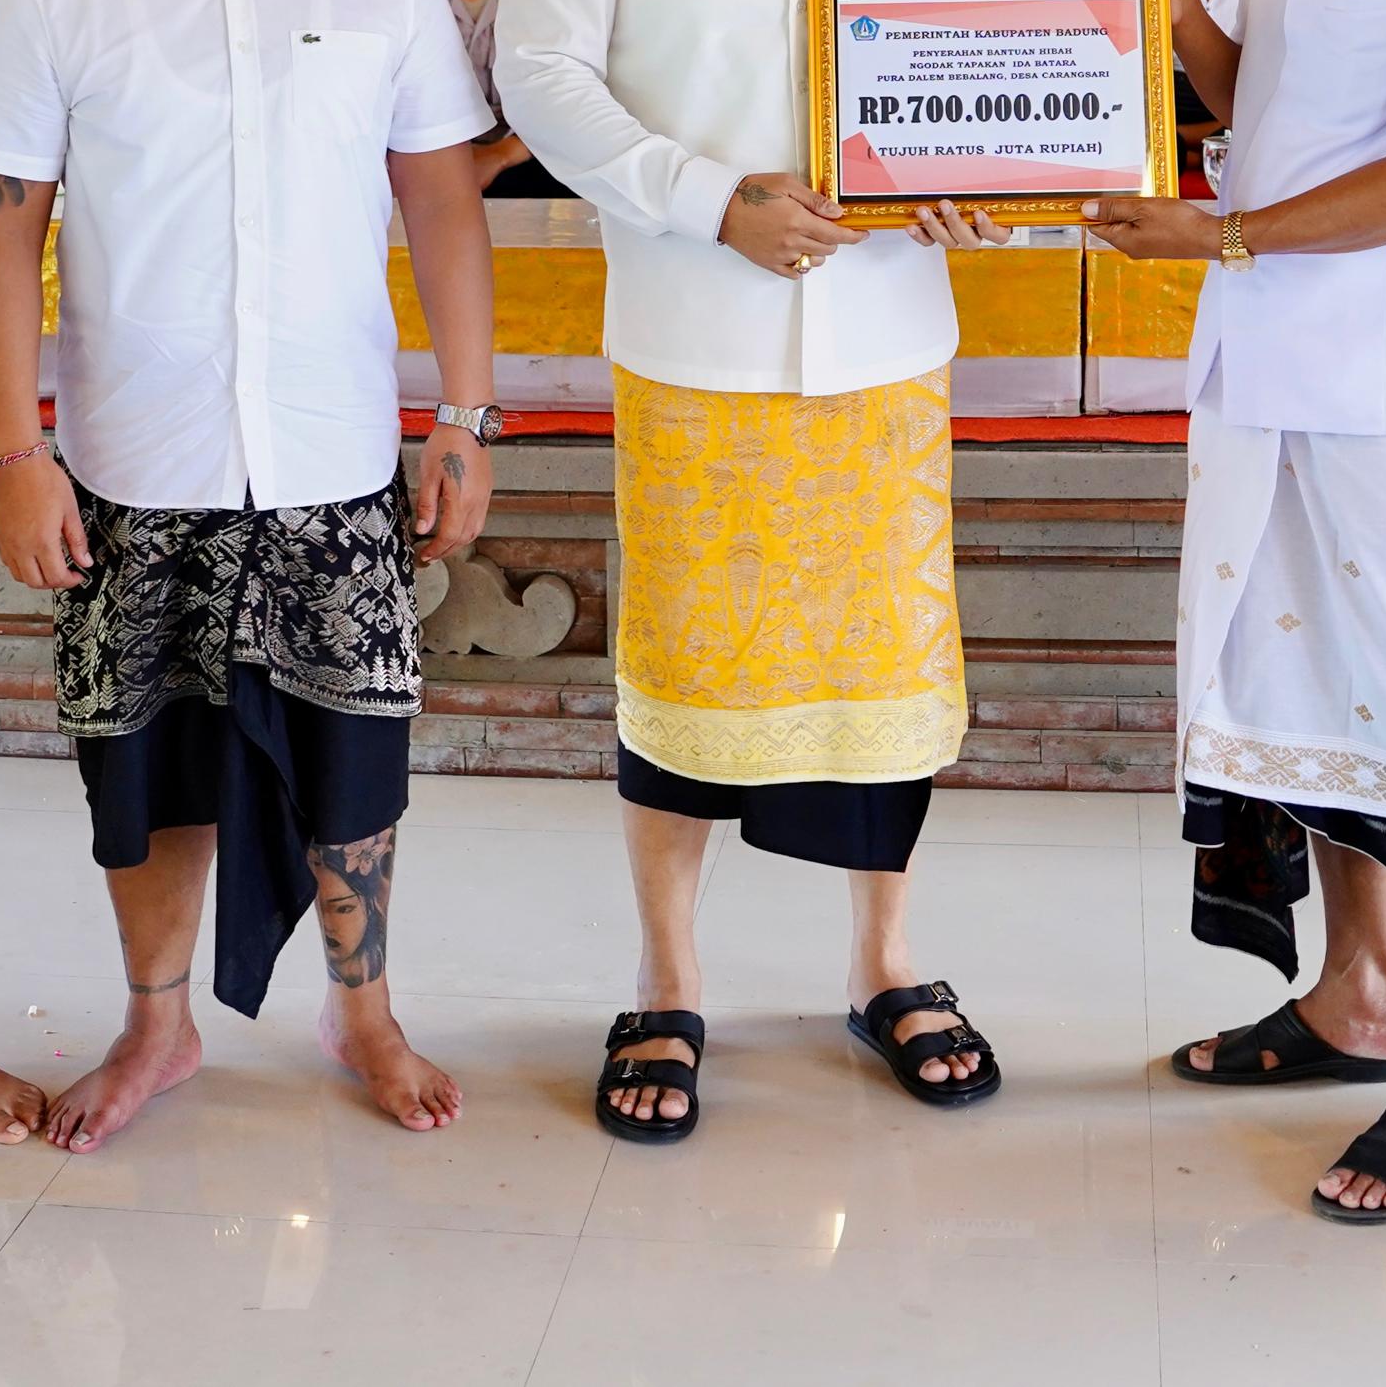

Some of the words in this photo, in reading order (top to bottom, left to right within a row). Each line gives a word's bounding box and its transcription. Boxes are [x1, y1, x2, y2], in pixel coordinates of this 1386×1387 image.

[885, 30, 970, 41] PEMERINTAH
[974, 28, 1051, 39] KABUPATEN
[1055, 27, 1109, 37] BADUNG
[912, 49, 984, 58] PENYERAHAN
[986, 48, 1036, 57] BANTUAN
[1038, 47, 1073, 56] HIBAH
[909, 61, 954, 70] NGODAK
[956, 60, 1006, 69] TAPAKAN
[1012, 60, 1032, 68] IDA
[1034, 59, 1077, 68] BATARA
[876, 74, 906, 83] PURA
[908, 73, 945, 82] DALEM
[948, 72, 1007, 81] BEBALANG,
[1010, 72, 1039, 80] DESA
[1041, 70, 1110, 79] CARANGSARI
[858, 92, 1122, 124] RP.700.000.000.-
[877, 146, 930, 157] TUJUH
[934, 144, 985, 156] RATUS
[994, 143, 1035, 155] JUTA
[1038, 141, 1103, 156] RUPIAH)
